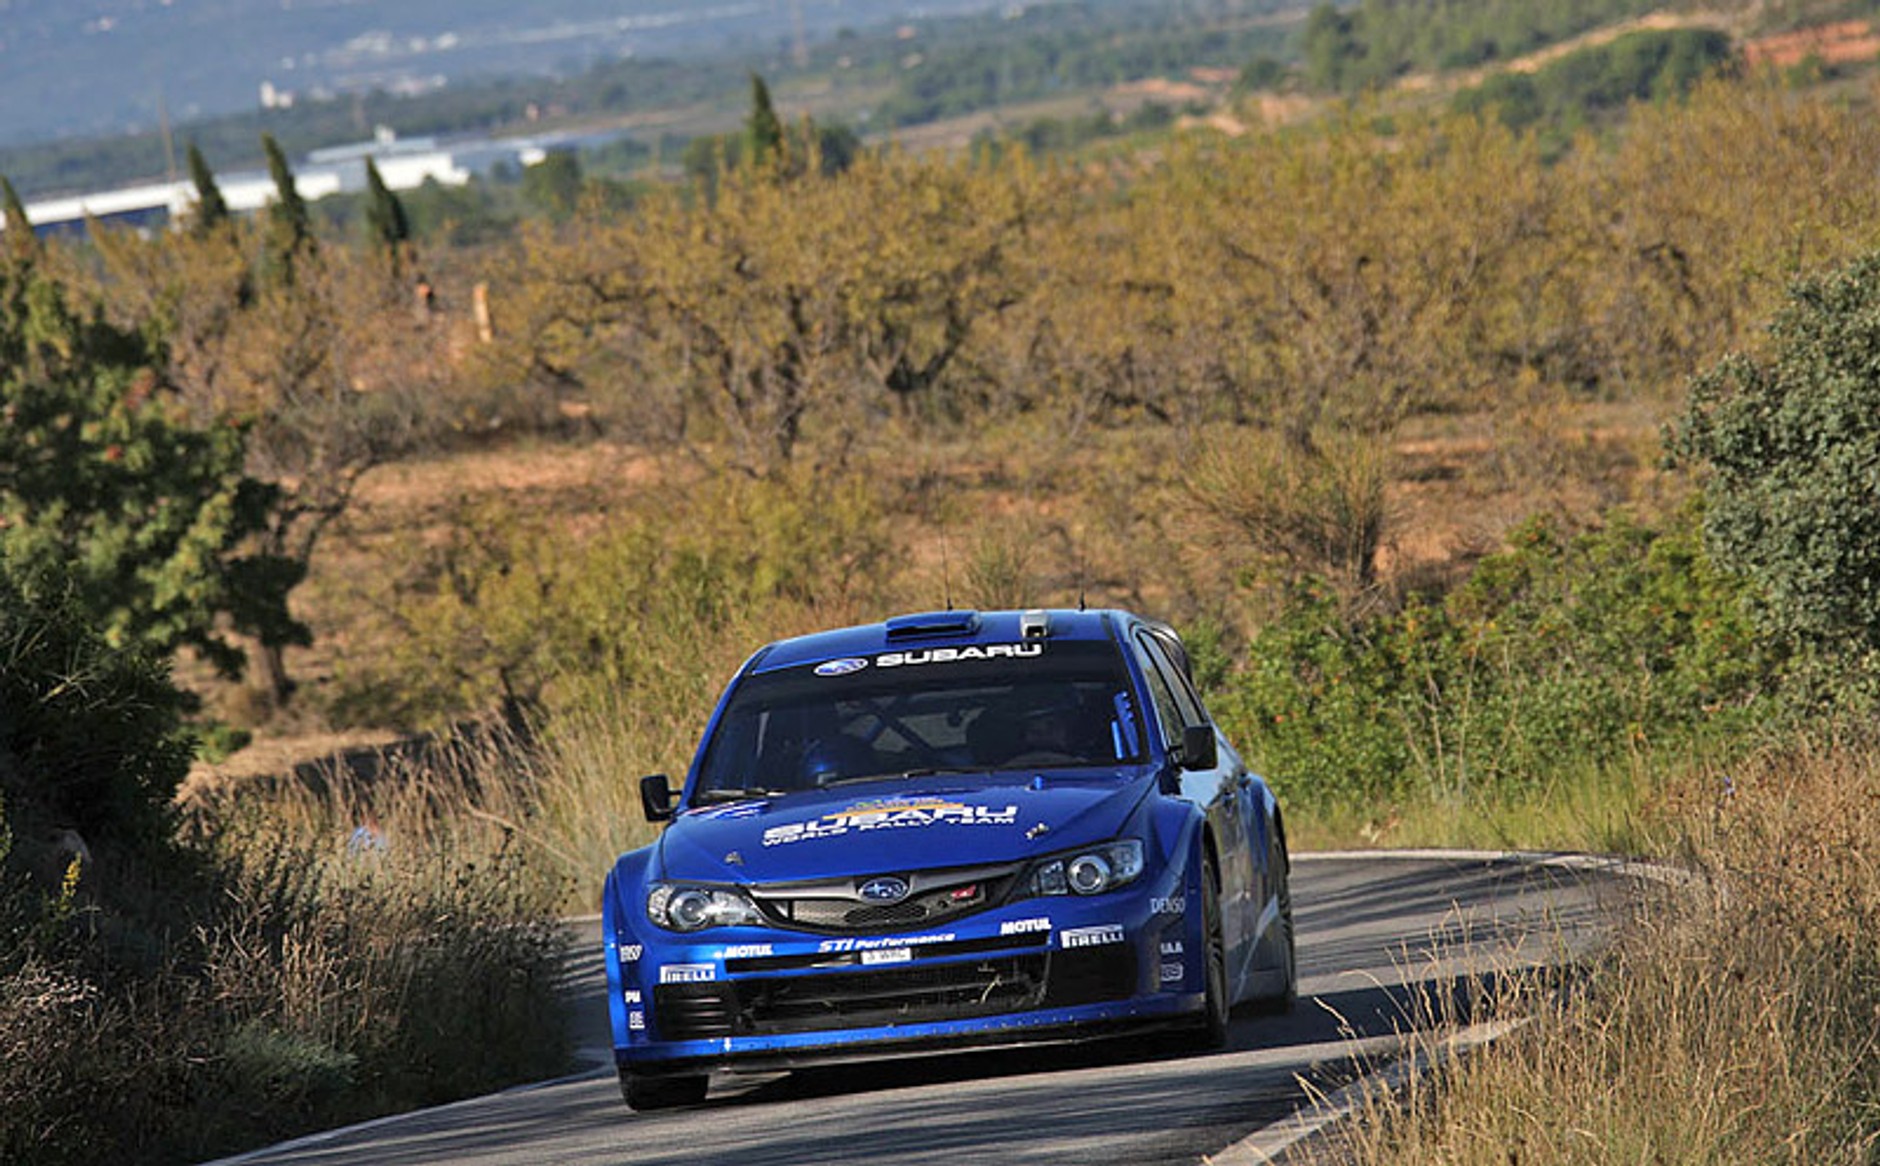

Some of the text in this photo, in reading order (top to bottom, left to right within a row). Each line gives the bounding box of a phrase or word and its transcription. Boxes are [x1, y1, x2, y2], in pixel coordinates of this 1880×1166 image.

[876, 644, 1042, 667] SUBARU
[762, 816, 1015, 847] WORLD RALLY TEAM
[763, 806, 1018, 840] SUBARU
[1151, 898, 1186, 914] DENSO
[1001, 917, 1052, 935] MOTUL
[1060, 924, 1124, 948] PIRELLI
[724, 944, 773, 958] MOTUL
[818, 933, 956, 953] STI Performance
[660, 963, 716, 984] PIRELLI
